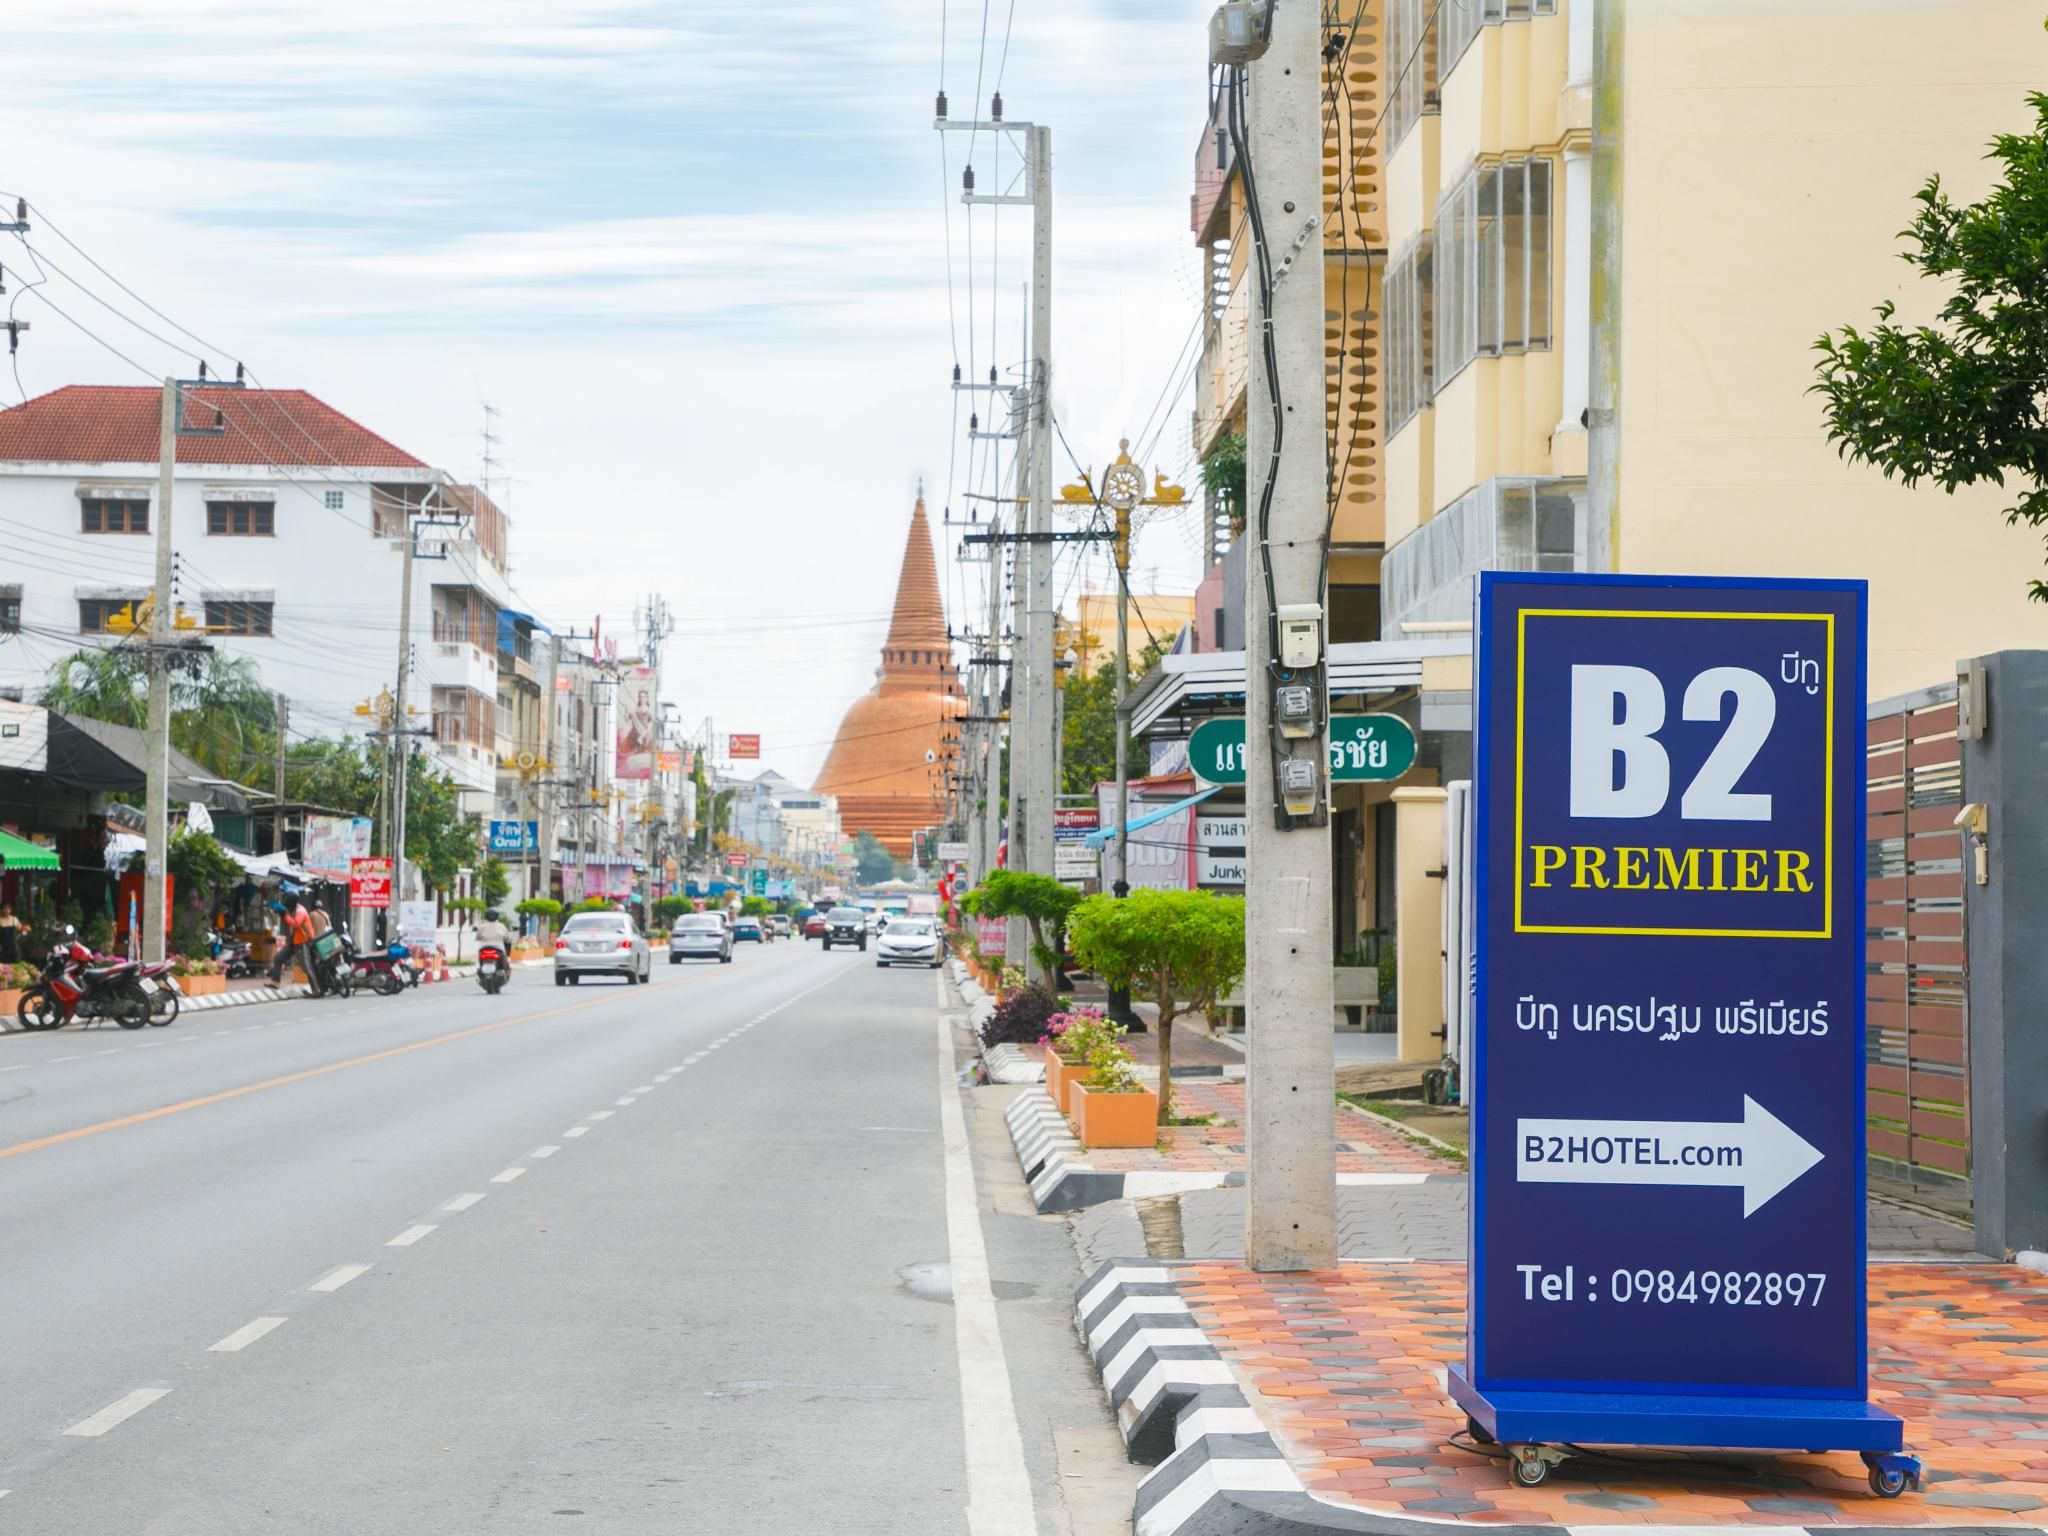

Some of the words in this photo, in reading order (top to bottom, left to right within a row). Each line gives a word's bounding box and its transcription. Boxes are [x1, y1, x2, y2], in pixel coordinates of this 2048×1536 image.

[1781, 650, 1819, 695] บีทู
[1569, 663, 1777, 822] B2
[1529, 844, 1815, 894] PREMIER
[1516, 994, 1559, 1041] บีทู
[1573, 996, 1701, 1042] นครปฐม
[1715, 999, 1829, 1037] พรีเมียร์
[1525, 1135, 1743, 1167] B2HOTEL.com
[1516, 1264, 1574, 1302] Tel
[1611, 1268, 1827, 1308] 0984982897
